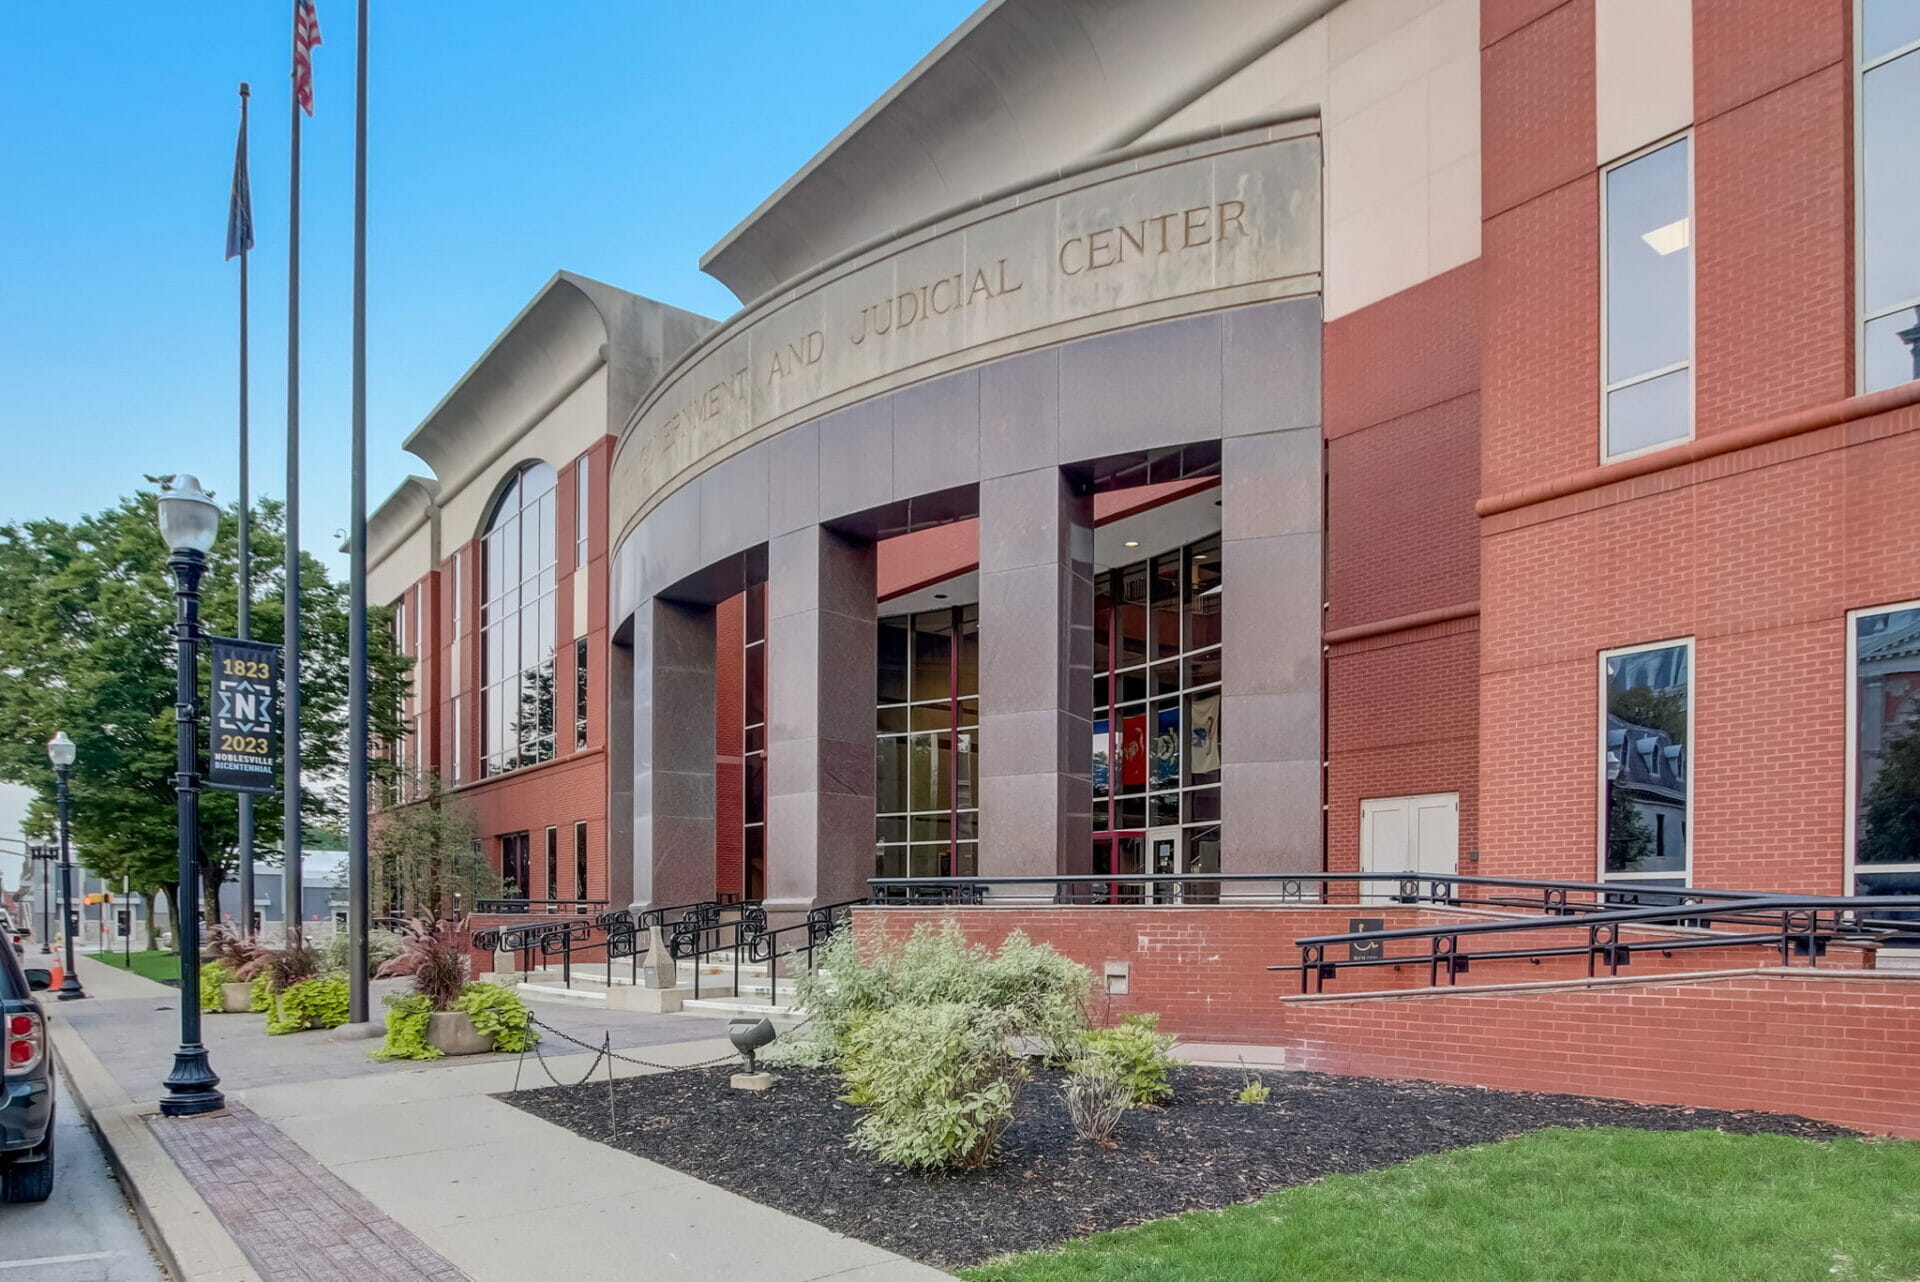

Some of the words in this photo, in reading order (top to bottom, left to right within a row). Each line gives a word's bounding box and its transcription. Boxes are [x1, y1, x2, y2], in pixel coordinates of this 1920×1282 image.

[639, 366, 750, 474] ERNMENT
[767, 329, 825, 385] AND
[850, 258, 1024, 345] JUDICIAL
[1058, 200, 1250, 276] CENTER
[222, 658, 270, 680] 1823
[234, 692, 256, 721] N
[220, 734, 269, 755] 2023
[214, 752, 273, 766] NOBLESVILLE
[214, 761, 273, 774] BICENTENNIAL
